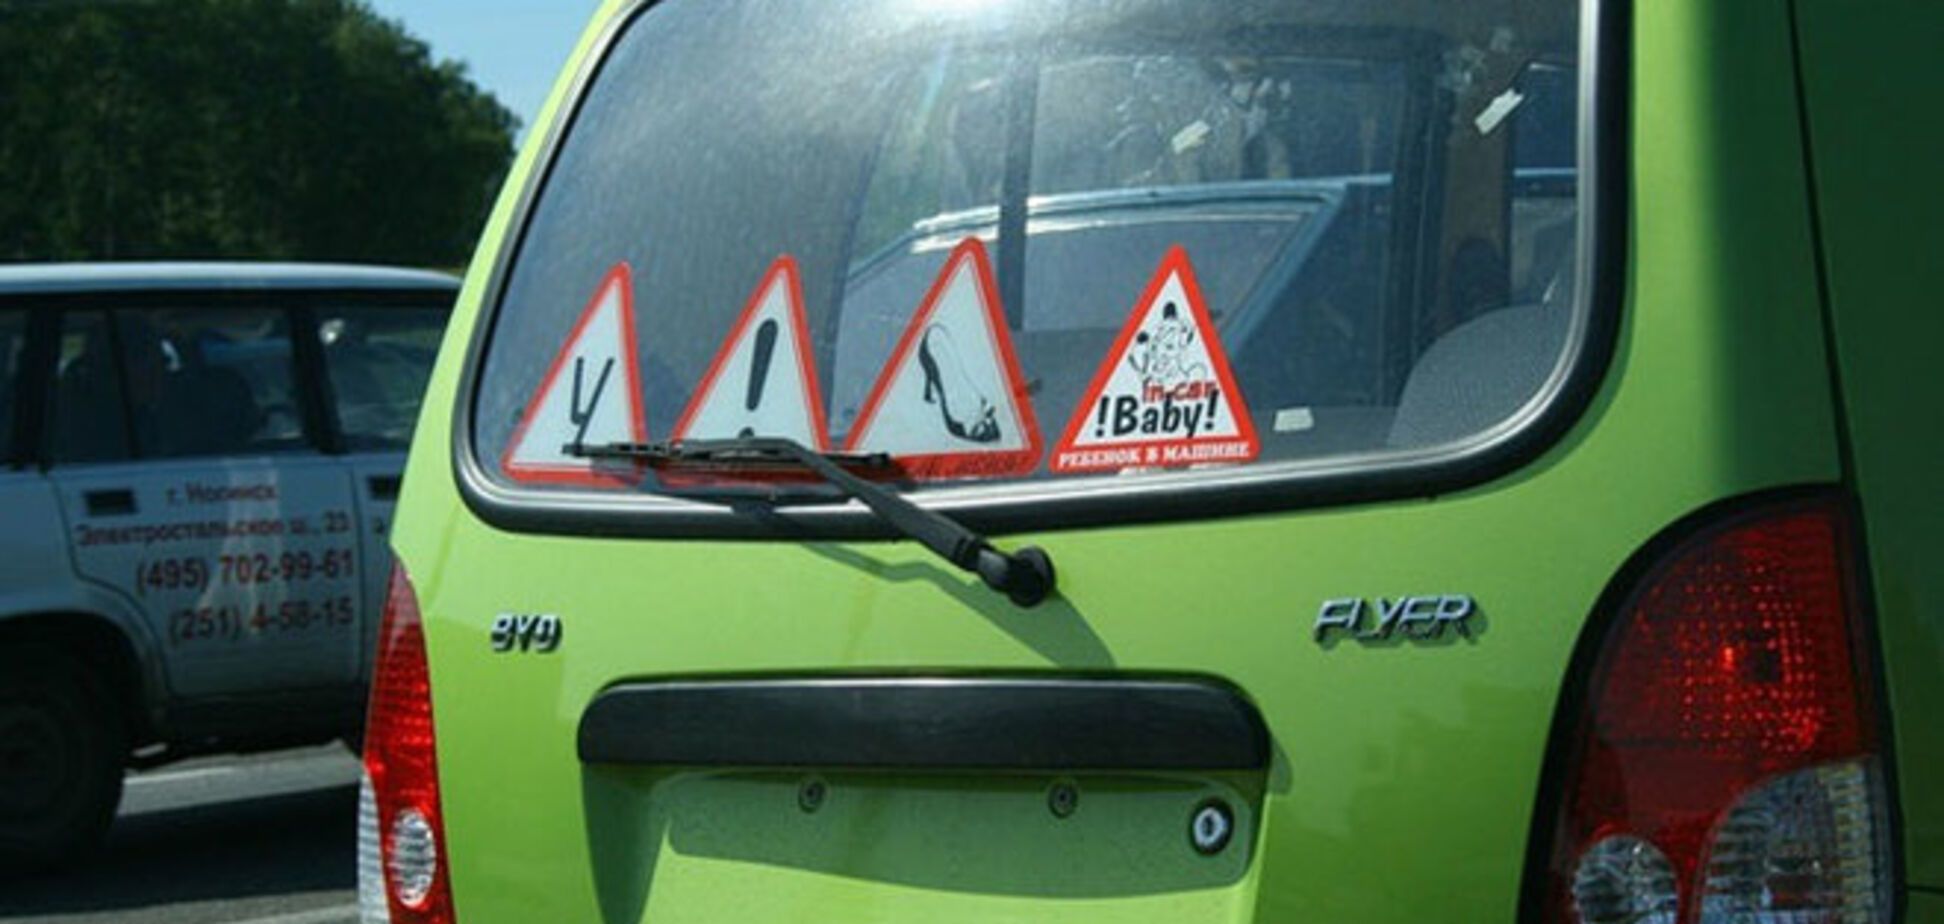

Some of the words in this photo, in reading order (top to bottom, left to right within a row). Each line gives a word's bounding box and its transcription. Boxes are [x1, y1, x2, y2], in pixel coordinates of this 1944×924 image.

[1163, 442, 1250, 462] МАШИНЕ
[136, 555, 209, 597] (495)
[219, 549, 353, 586] 702-99-61
[169, 604, 243, 646] (251)
[491, 613, 562, 653] BYD
[1314, 594, 1475, 641] FLYER
